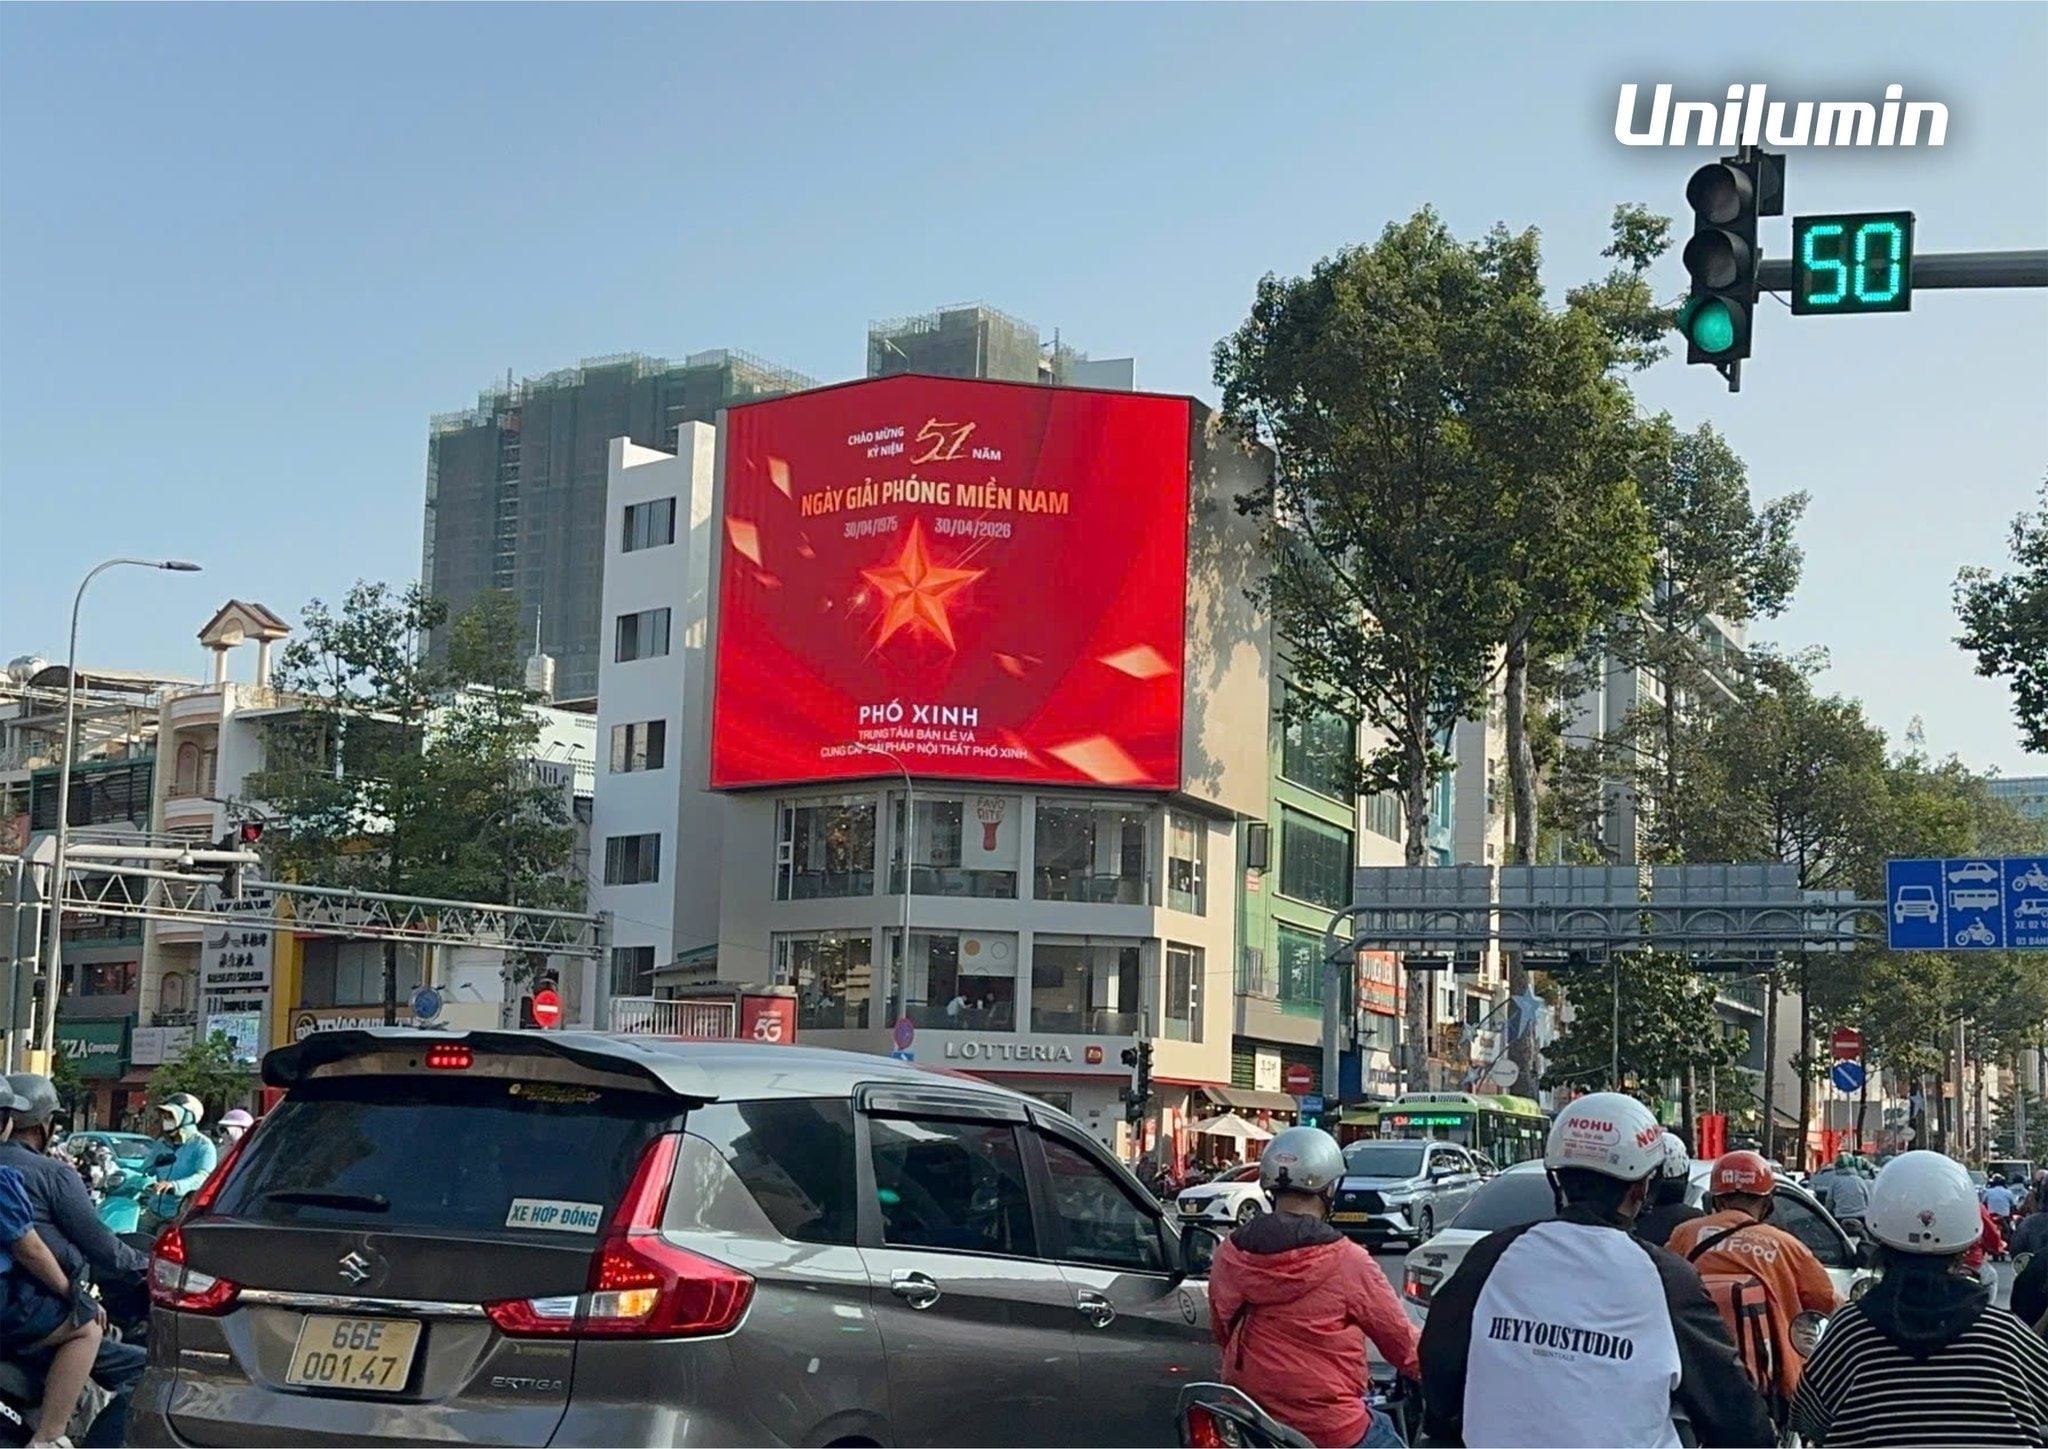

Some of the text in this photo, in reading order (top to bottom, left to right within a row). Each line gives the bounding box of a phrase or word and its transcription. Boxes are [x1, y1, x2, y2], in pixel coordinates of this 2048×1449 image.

[1804, 222, 1901, 303] 50
[910, 417, 1002, 465] 51 NĂM
[801, 473, 1069, 517] NGÀY GIẢI PHÓNG MIỀN NAM
[843, 515, 1012, 540] 30/04/1975 30/04/2026
[859, 698, 978, 727] PHỐ XINH
[858, 728, 889, 741] TRUNG
[889, 726, 914, 739] TÂM
[916, 728, 942, 741] BÁN
[959, 730, 976, 743] VÀ
[820, 746, 847, 758] CUNG
[916, 741, 938, 756] NỘI
[940, 742, 971, 757] THẤT
[1000, 747, 1028, 760] XINH
[753, 1018, 782, 1042] 5G
[945, 1042, 1073, 1062] LOTTERIA
[1568, 1118, 1613, 1132] NOHU
[511, 1205, 530, 1221] XE
[531, 1205, 559, 1226] HỢP
[1728, 1239, 1778, 1264] Food
[332, 1320, 385, 1351] 66E
[1488, 1316, 1634, 1361] HEYYOUSTUDIO
[302, 1351, 397, 1386] 001.47
[491, 1376, 562, 1391] ERTIGA
